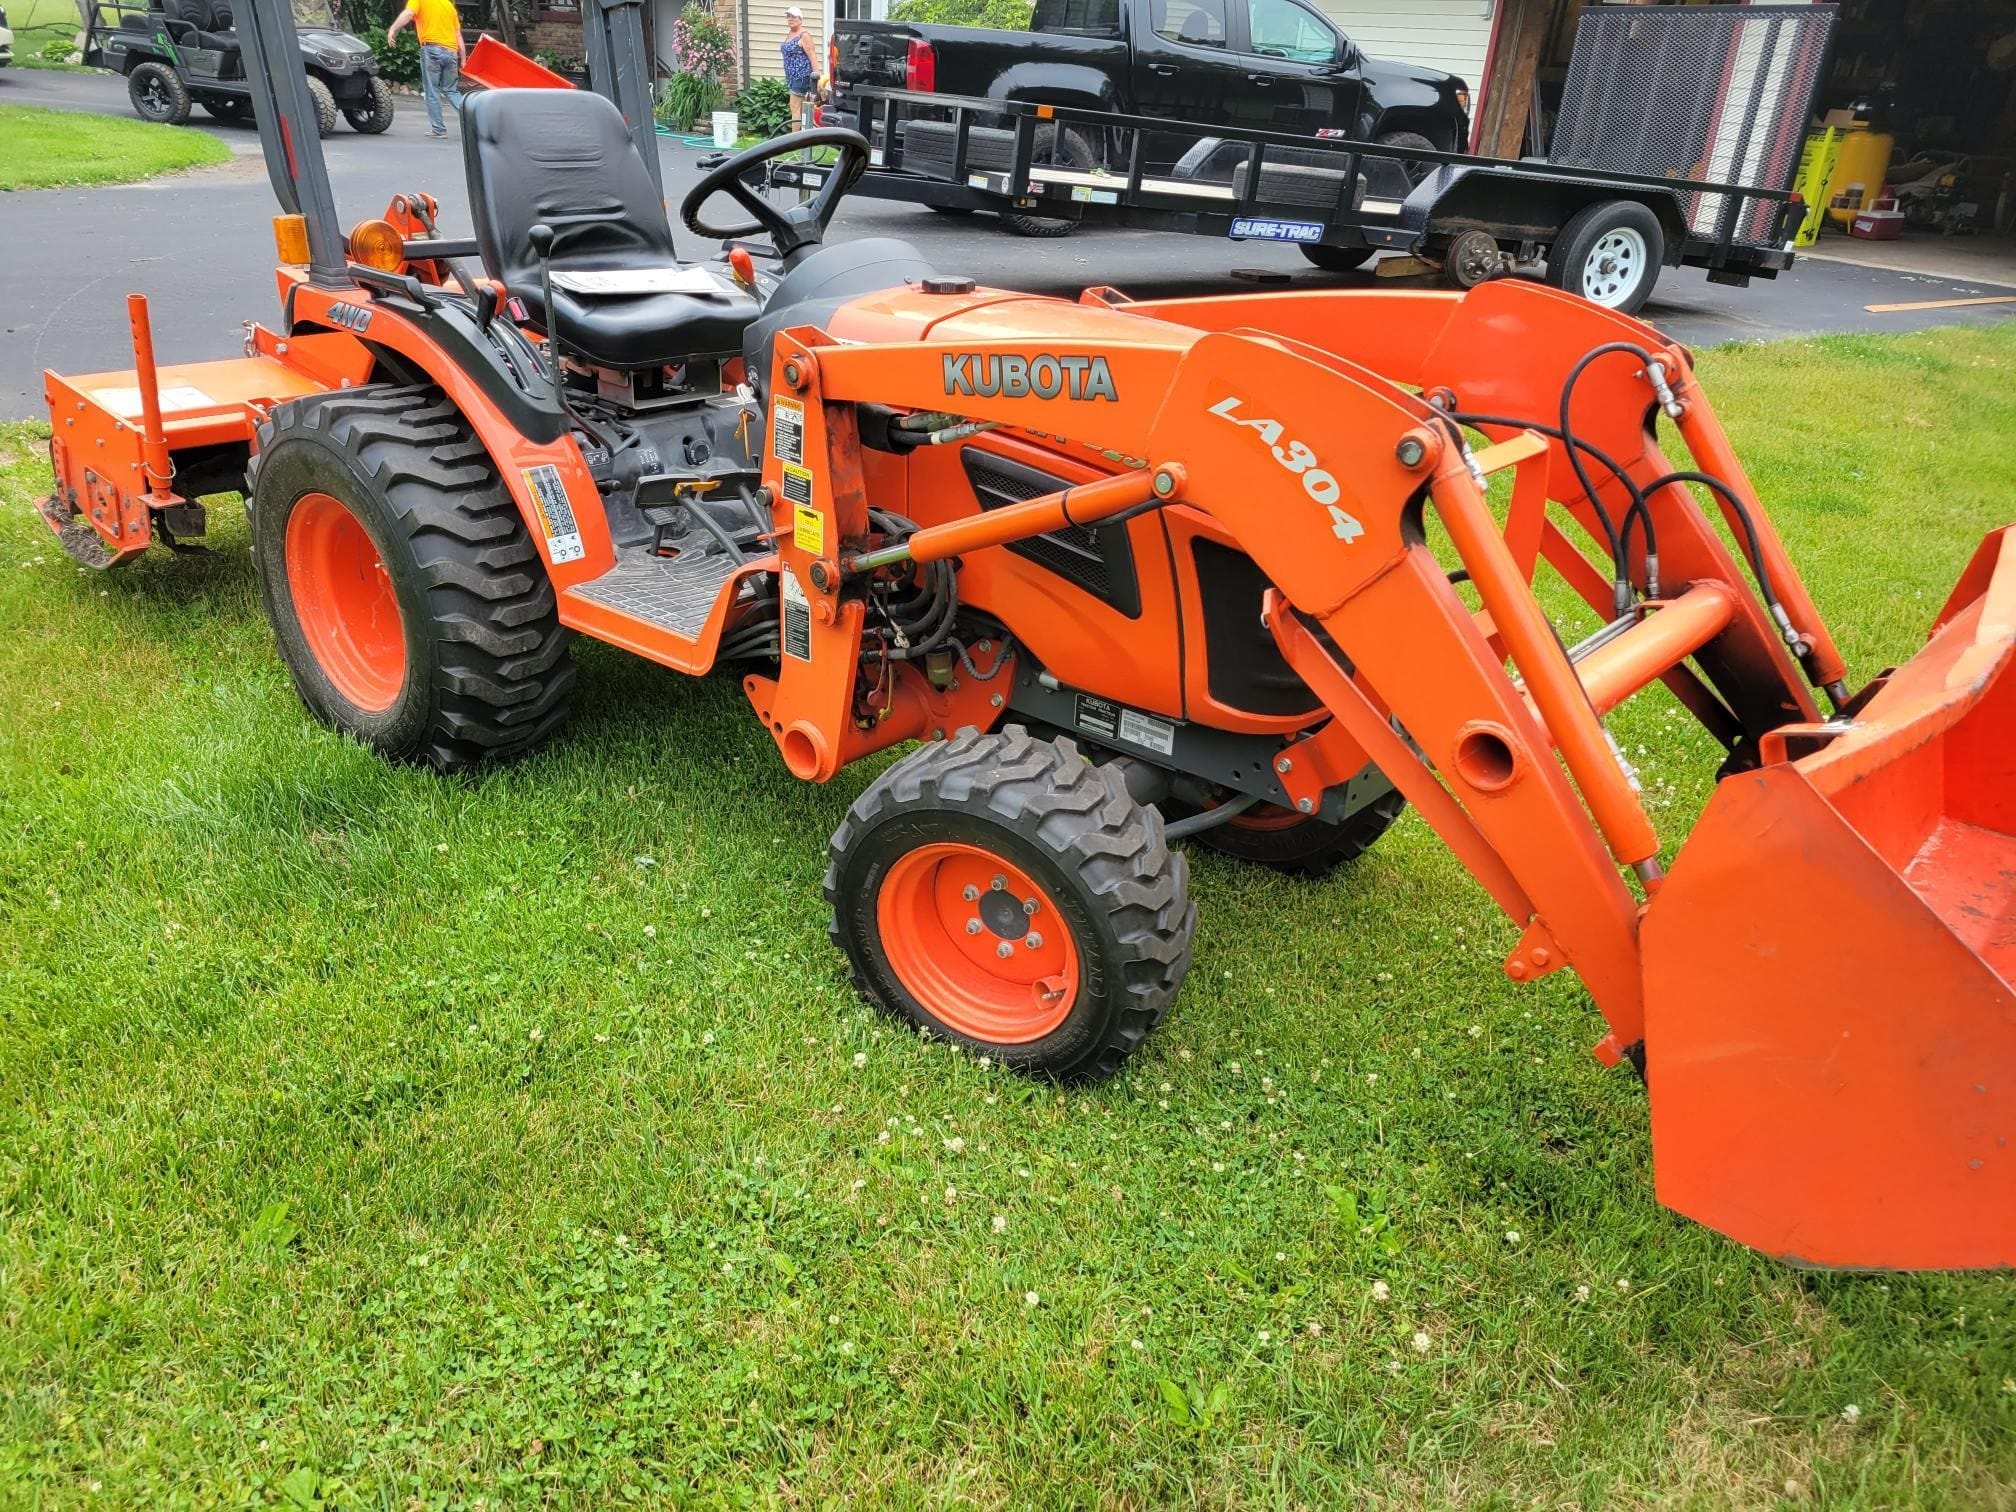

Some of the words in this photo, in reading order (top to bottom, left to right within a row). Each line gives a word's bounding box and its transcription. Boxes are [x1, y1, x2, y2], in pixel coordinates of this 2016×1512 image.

[1233, 221, 1321, 241] SURE-TRAC
[326, 302, 374, 333] 4WD
[942, 352, 1119, 402] KUBOTA
[789, 466, 810, 478] CAUTION
[1207, 396, 1365, 545] LA304
[1085, 698, 1111, 711] KUBOTA
